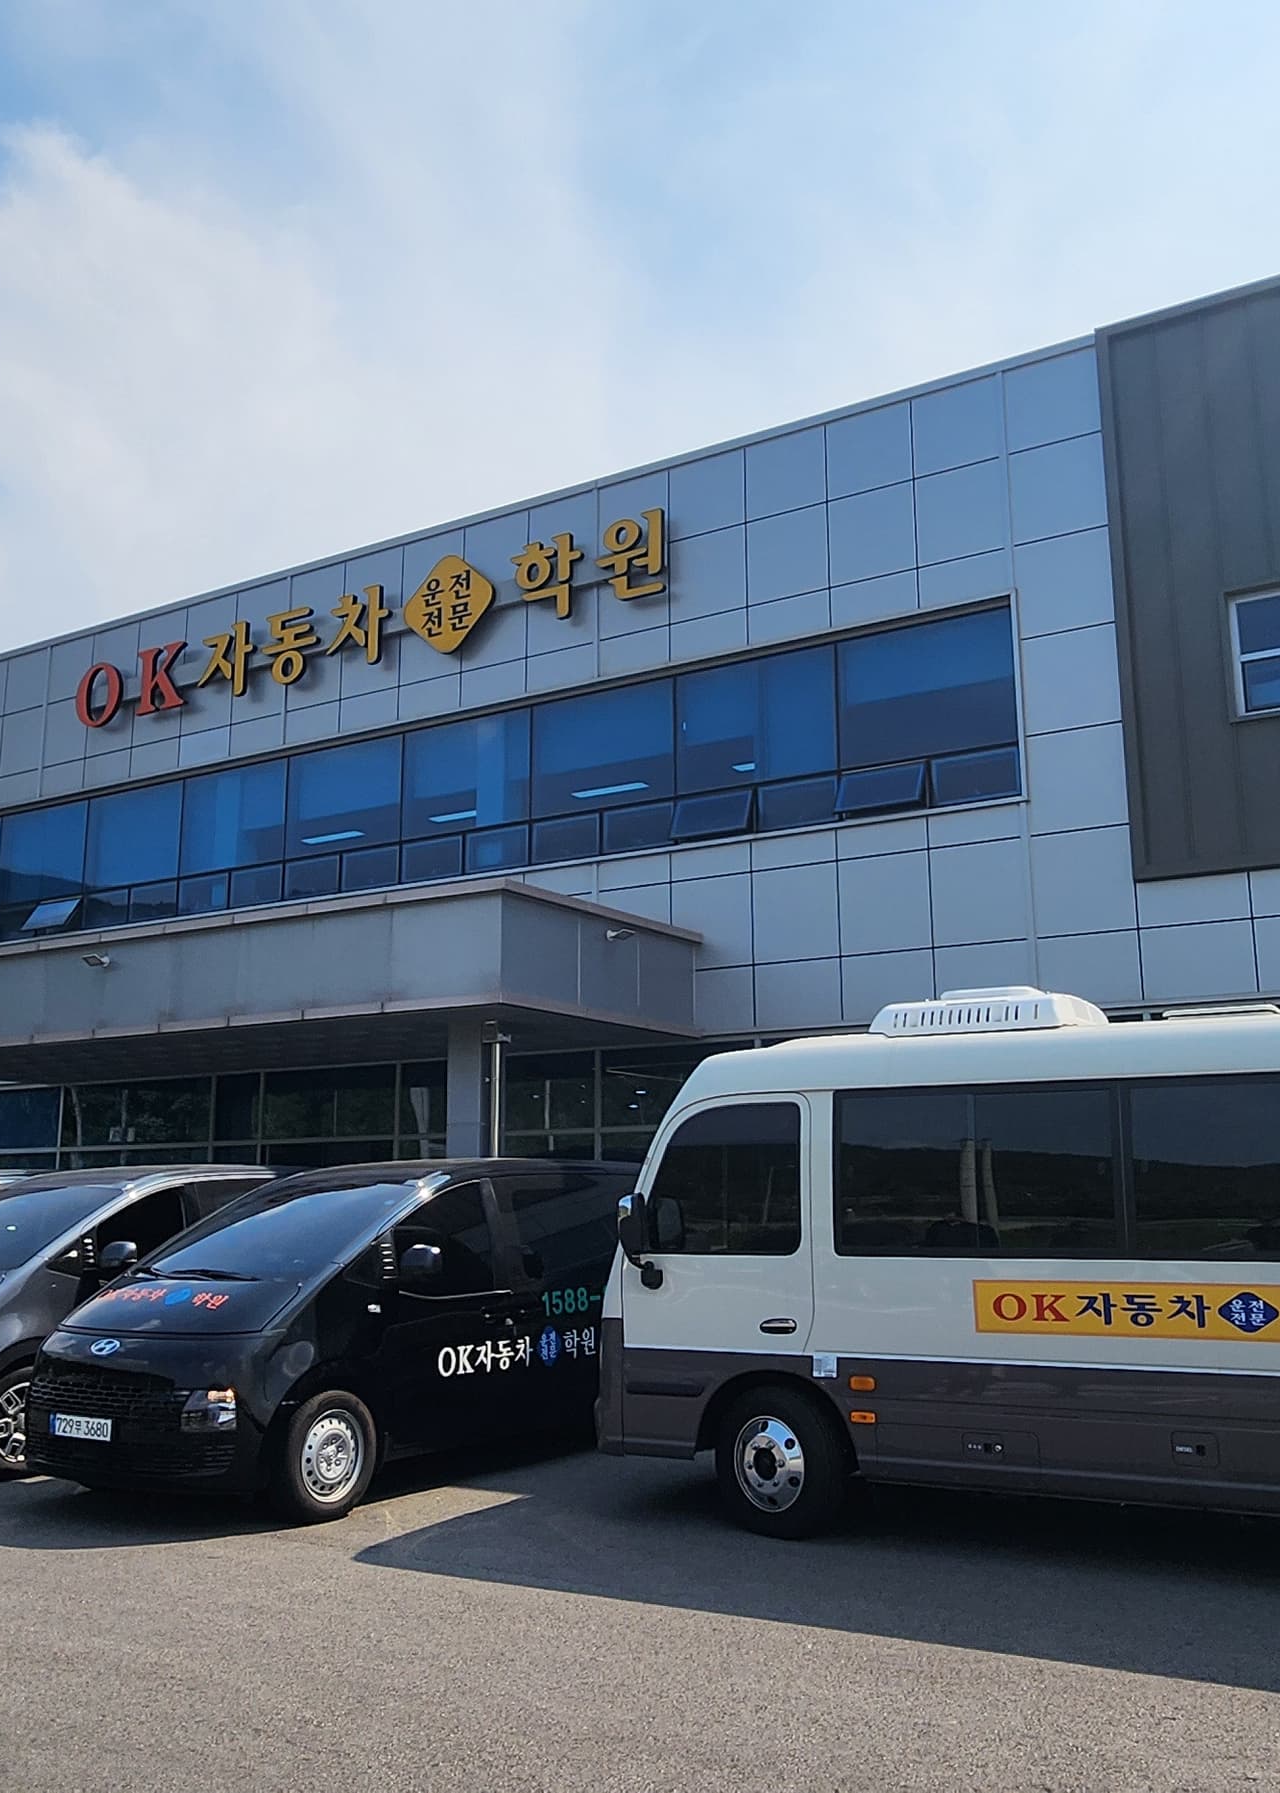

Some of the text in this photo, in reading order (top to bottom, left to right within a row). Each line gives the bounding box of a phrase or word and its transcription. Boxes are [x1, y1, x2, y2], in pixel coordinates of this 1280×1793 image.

[510, 508, 666, 620] 학원
[421, 569, 472, 608] 운전
[421, 601, 473, 638] 전문
[542, 1286, 608, 1317] 1588-
[1229, 1299, 1265, 1313] 운전
[1230, 1312, 1267, 1326] 전문
[563, 1326, 597, 1359] 학원
[83, 1421, 109, 1439] 3680
